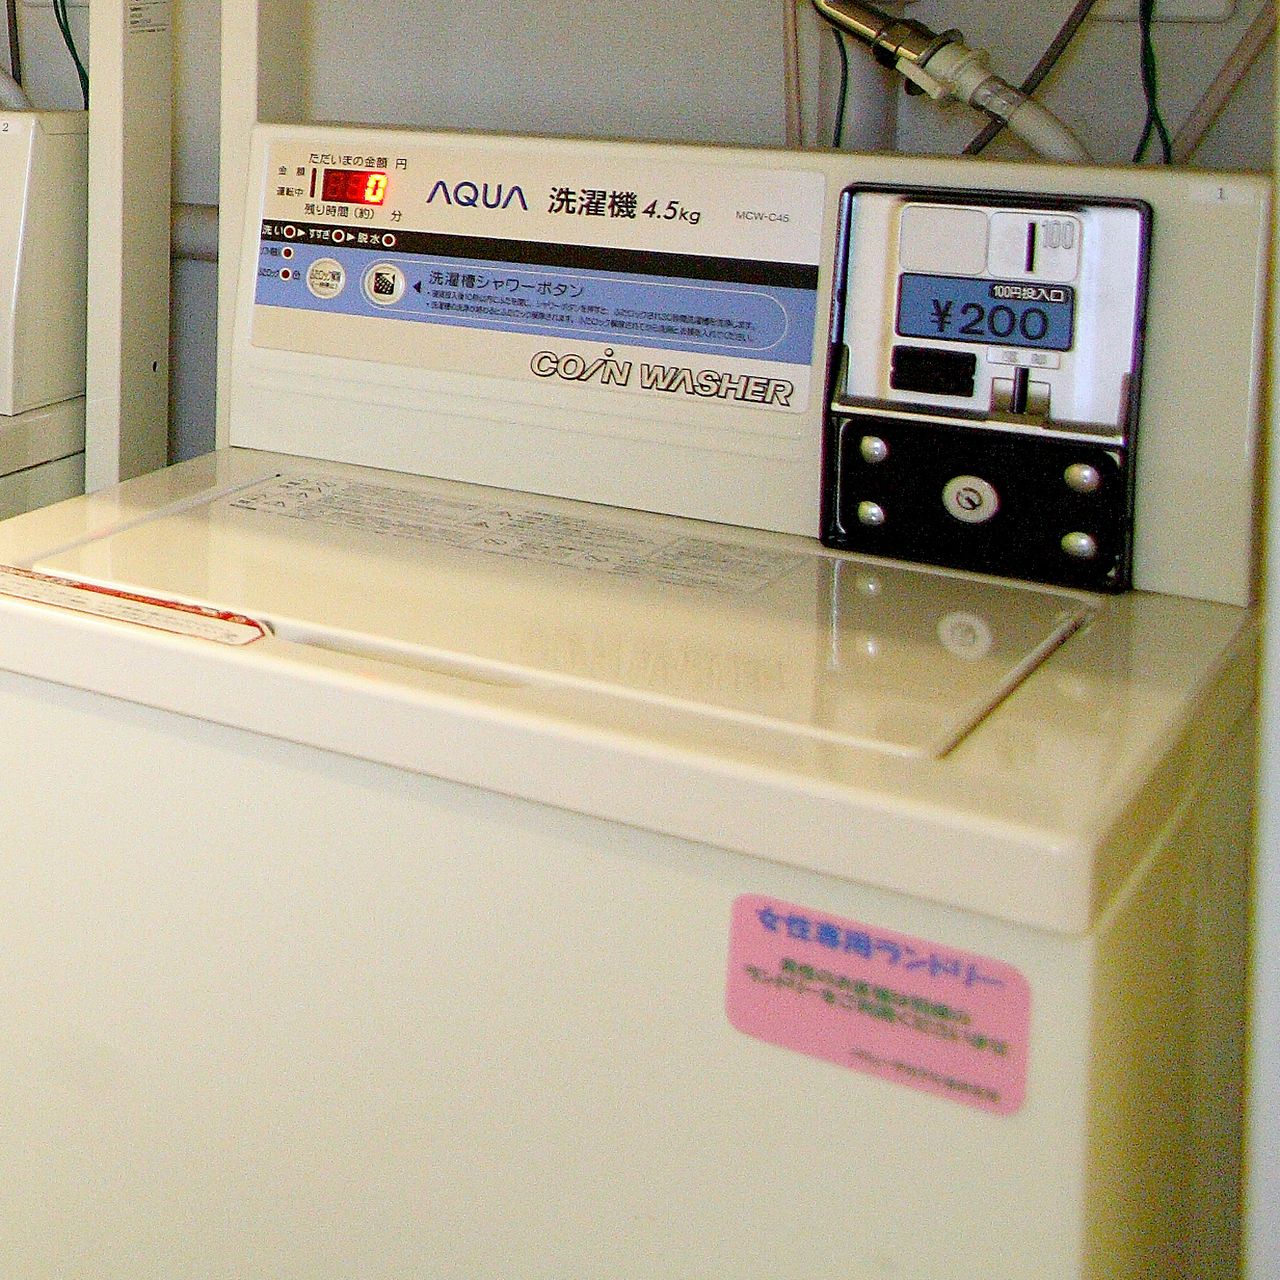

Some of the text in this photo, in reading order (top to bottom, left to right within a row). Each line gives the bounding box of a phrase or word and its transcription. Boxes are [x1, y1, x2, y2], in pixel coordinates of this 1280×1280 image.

[2, 122, 10, 133] 2
[309, 153, 408, 170] ただいまの金額 円
[276, 187, 304, 198] 運転中
[364, 174, 389, 204] 0
[426, 180, 530, 214] AQUA
[548, 186, 638, 220] 洗濯機
[642, 200, 701, 225] 4.5kg
[391, 210, 403, 222] 分
[261, 224, 284, 236] 洗い
[357, 232, 381, 244] 脱水
[1042, 220, 1075, 250] 100
[428, 269, 585, 298] 洗濯槽シャワーボタン
[930, 297, 1050, 341] ¥200
[530, 348, 794, 407] COIN WASHER
